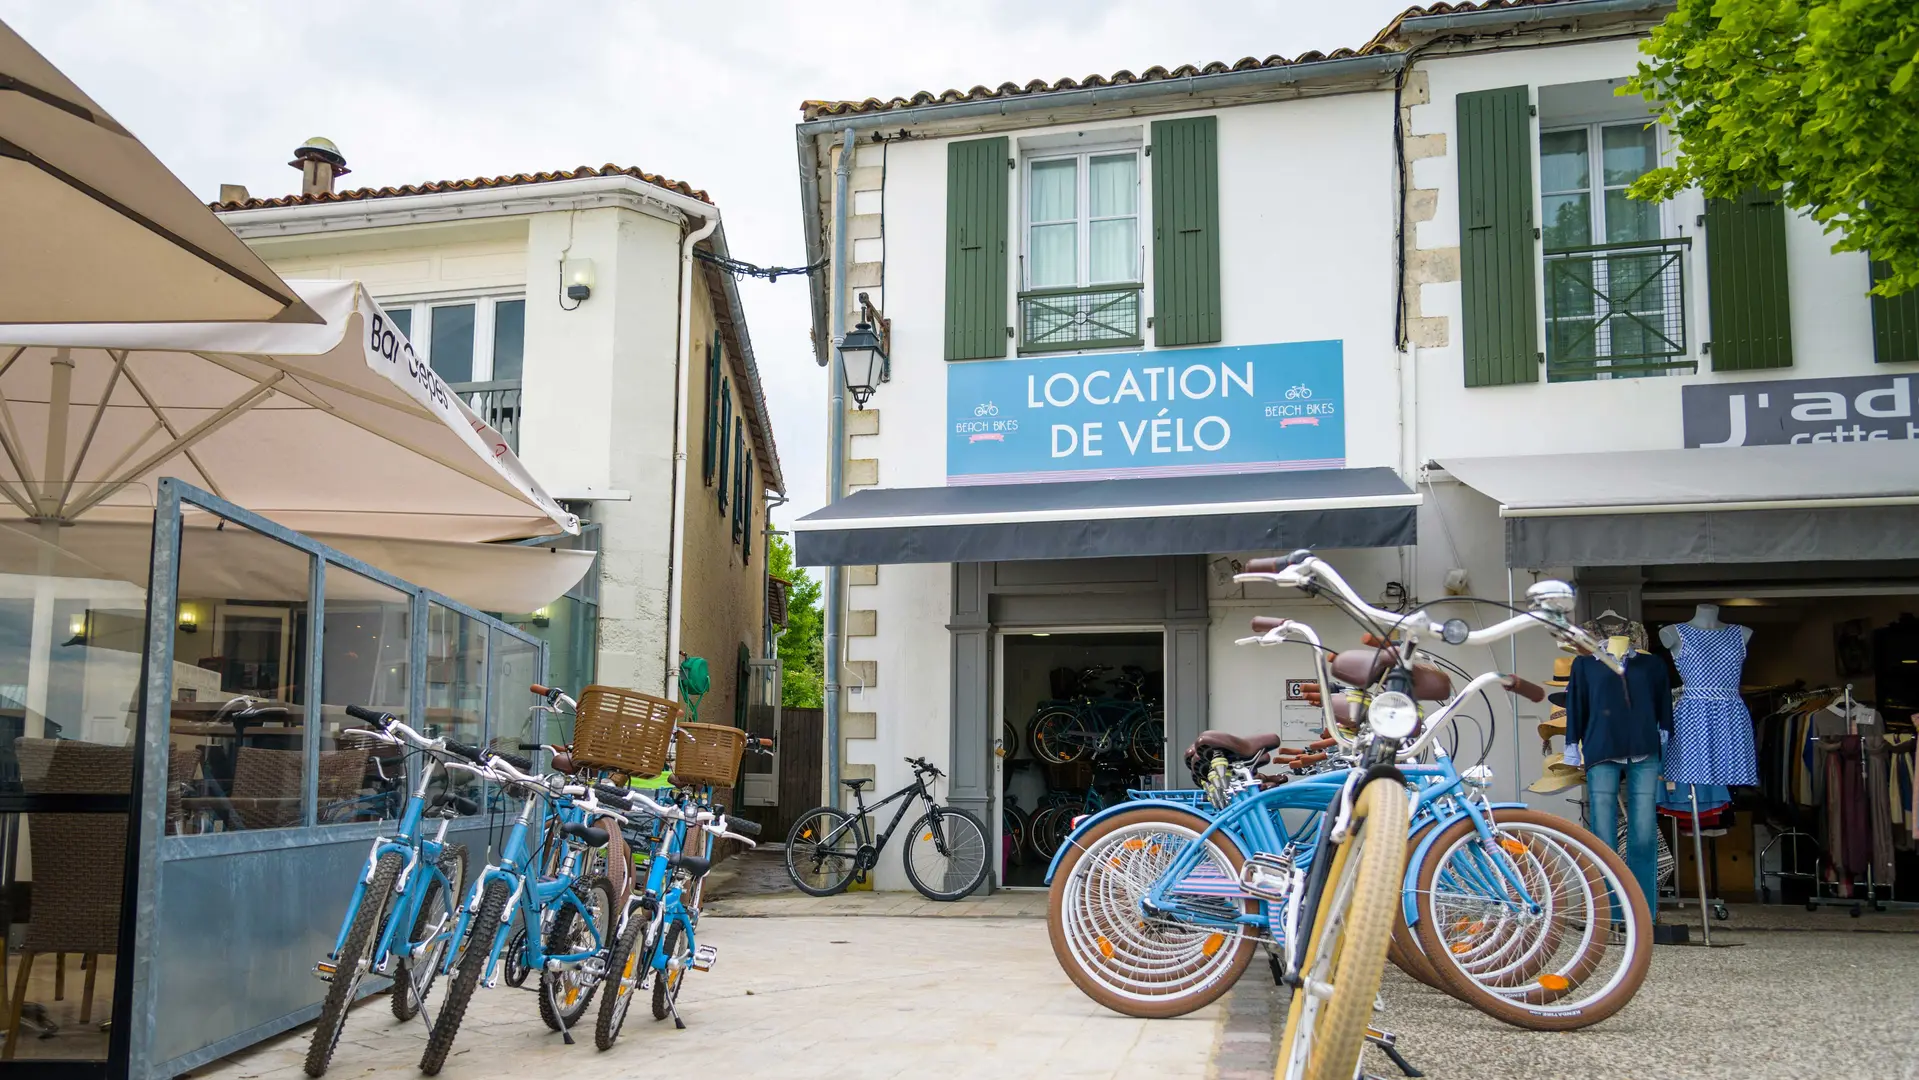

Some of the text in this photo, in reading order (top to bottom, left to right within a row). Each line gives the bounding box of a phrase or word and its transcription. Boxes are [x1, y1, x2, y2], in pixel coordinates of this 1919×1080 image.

[1028, 361, 1254, 408] LOCATION
[956, 419, 1019, 433] BEACH BIKES
[1051, 407, 1231, 458] DE VÉLO
[1264, 402, 1335, 417] BEACH BIKES
[1699, 377, 1919, 448] J'ad
